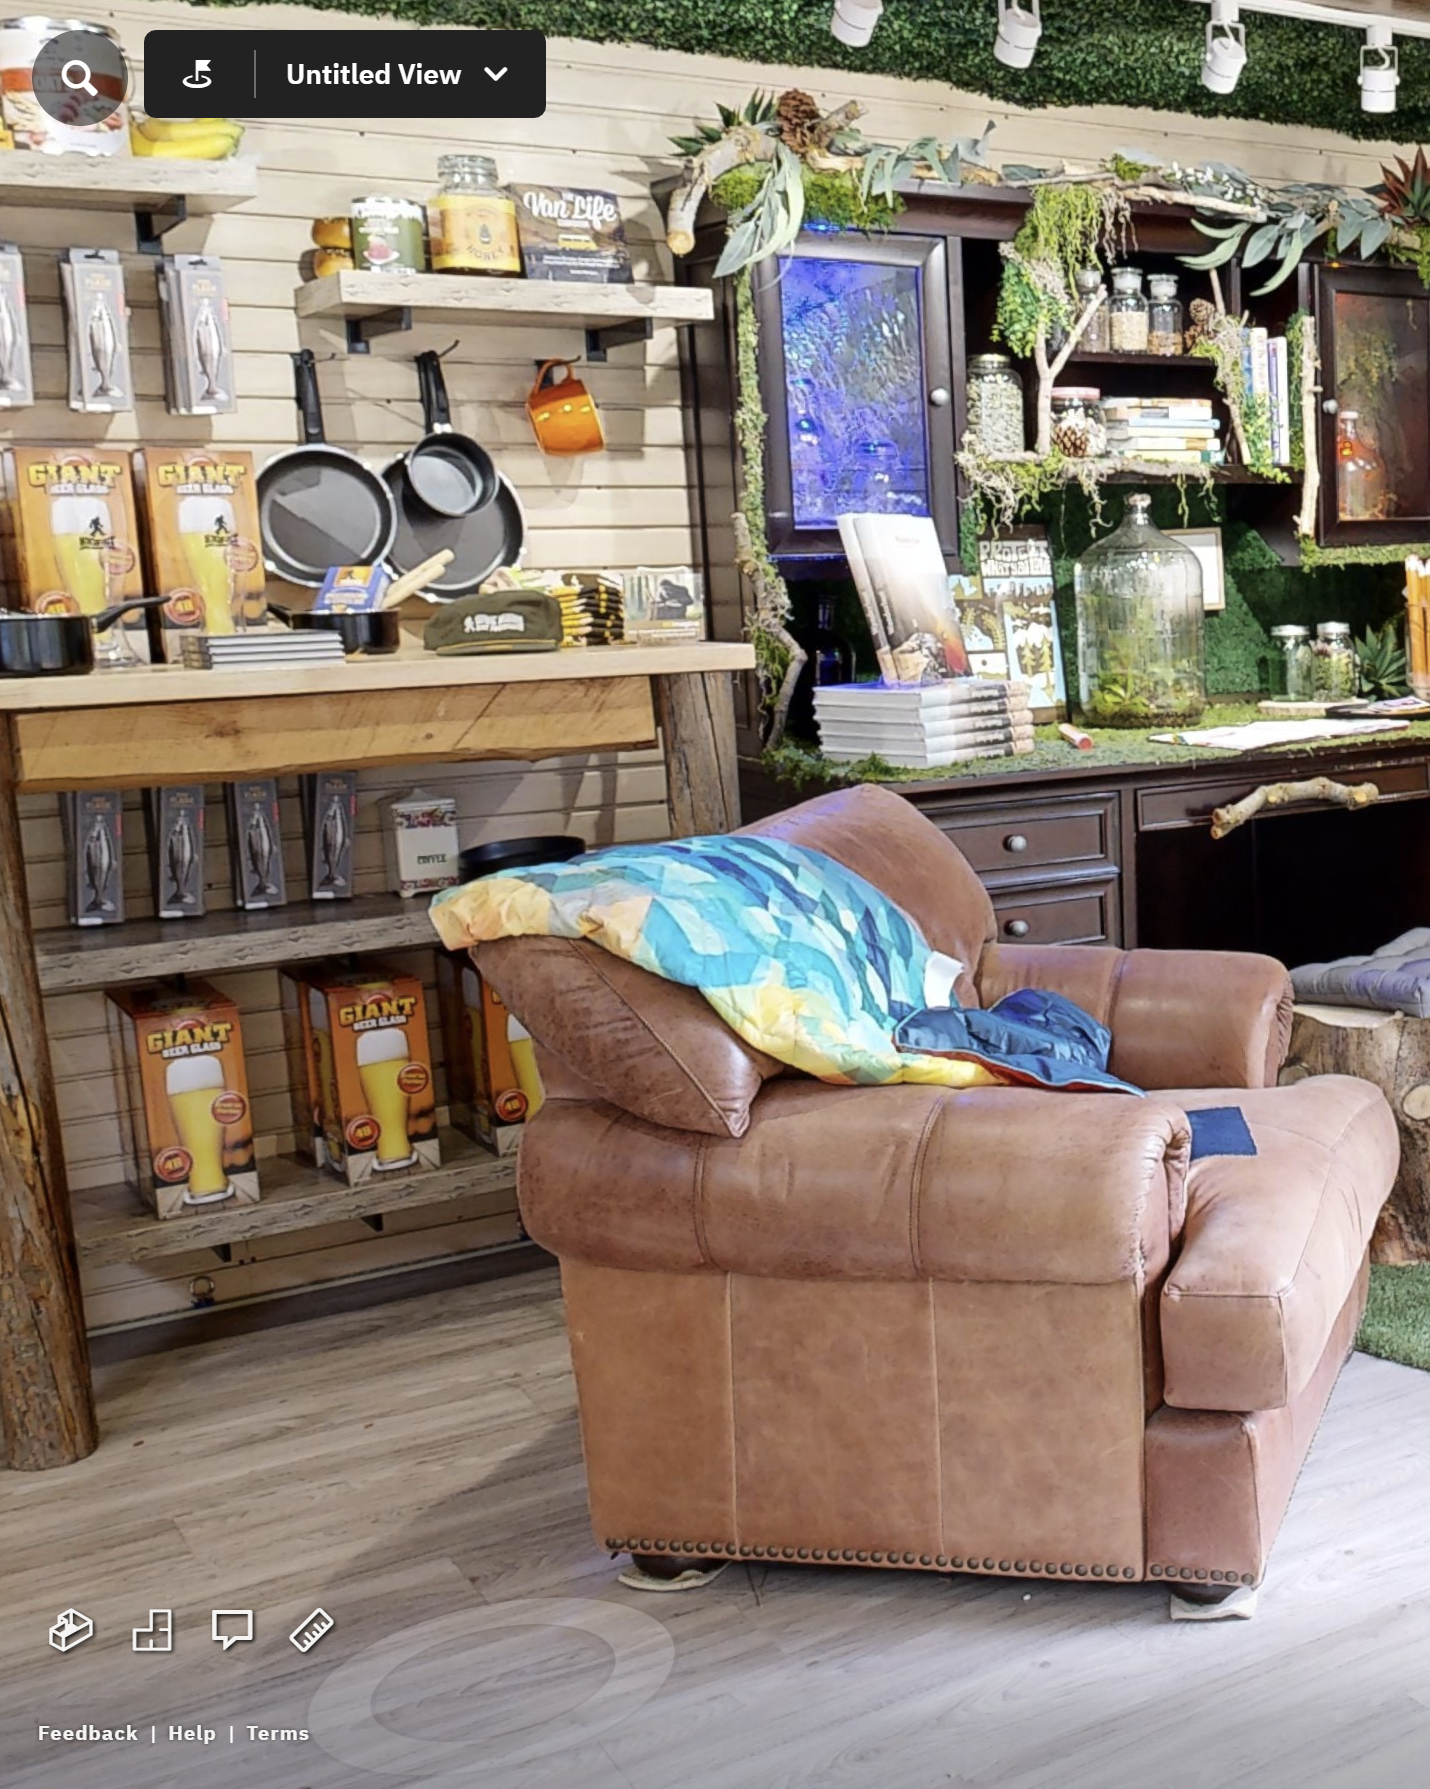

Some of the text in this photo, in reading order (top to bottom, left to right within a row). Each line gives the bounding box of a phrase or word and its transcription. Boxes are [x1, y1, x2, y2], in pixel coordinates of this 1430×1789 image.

[523, 192, 617, 231] Van Life
[28, 463, 122, 488] GIANT
[157, 463, 246, 487] GIANT
[979, 540, 1050, 562] PROTECT
[339, 997, 417, 1027] GIANT
[147, 1022, 232, 1053] GIANT
